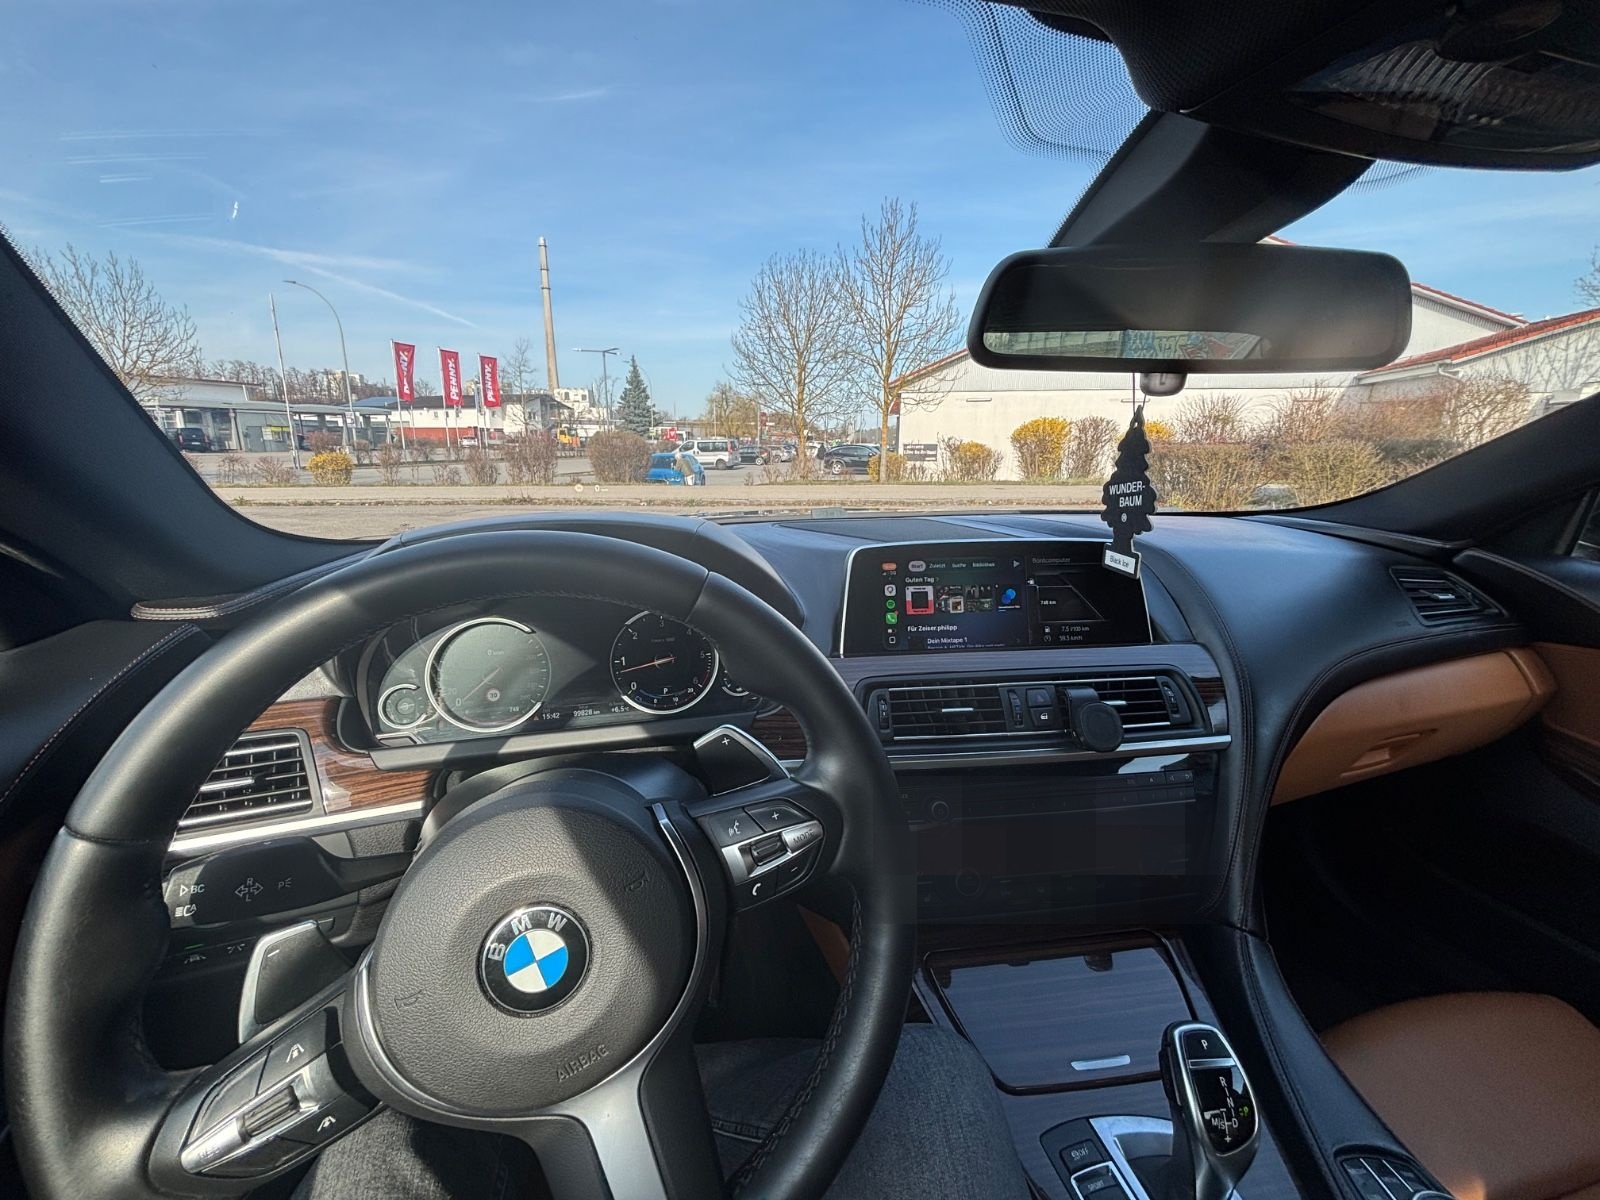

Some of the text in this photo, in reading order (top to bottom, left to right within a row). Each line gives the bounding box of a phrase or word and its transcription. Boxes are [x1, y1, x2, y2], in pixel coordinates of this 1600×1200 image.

[1109, 480, 1146, 496] WUNDER-
[1119, 495, 1142, 507] BAUM
[924, 576, 935, 584] Tag
[632, 632, 638, 640] 2
[620, 656, 626, 666] 1
[630, 682, 637, 690] 0
[542, 712, 560, 720] 15:42
[190, 883, 206, 894] BC
[488, 912, 567, 961] BMW
[1201, 1039, 1209, 1050] P
[556, 1045, 610, 1083] AIRBAG
[1219, 1076, 1228, 1088] R
[1232, 1117, 1239, 1128] D
